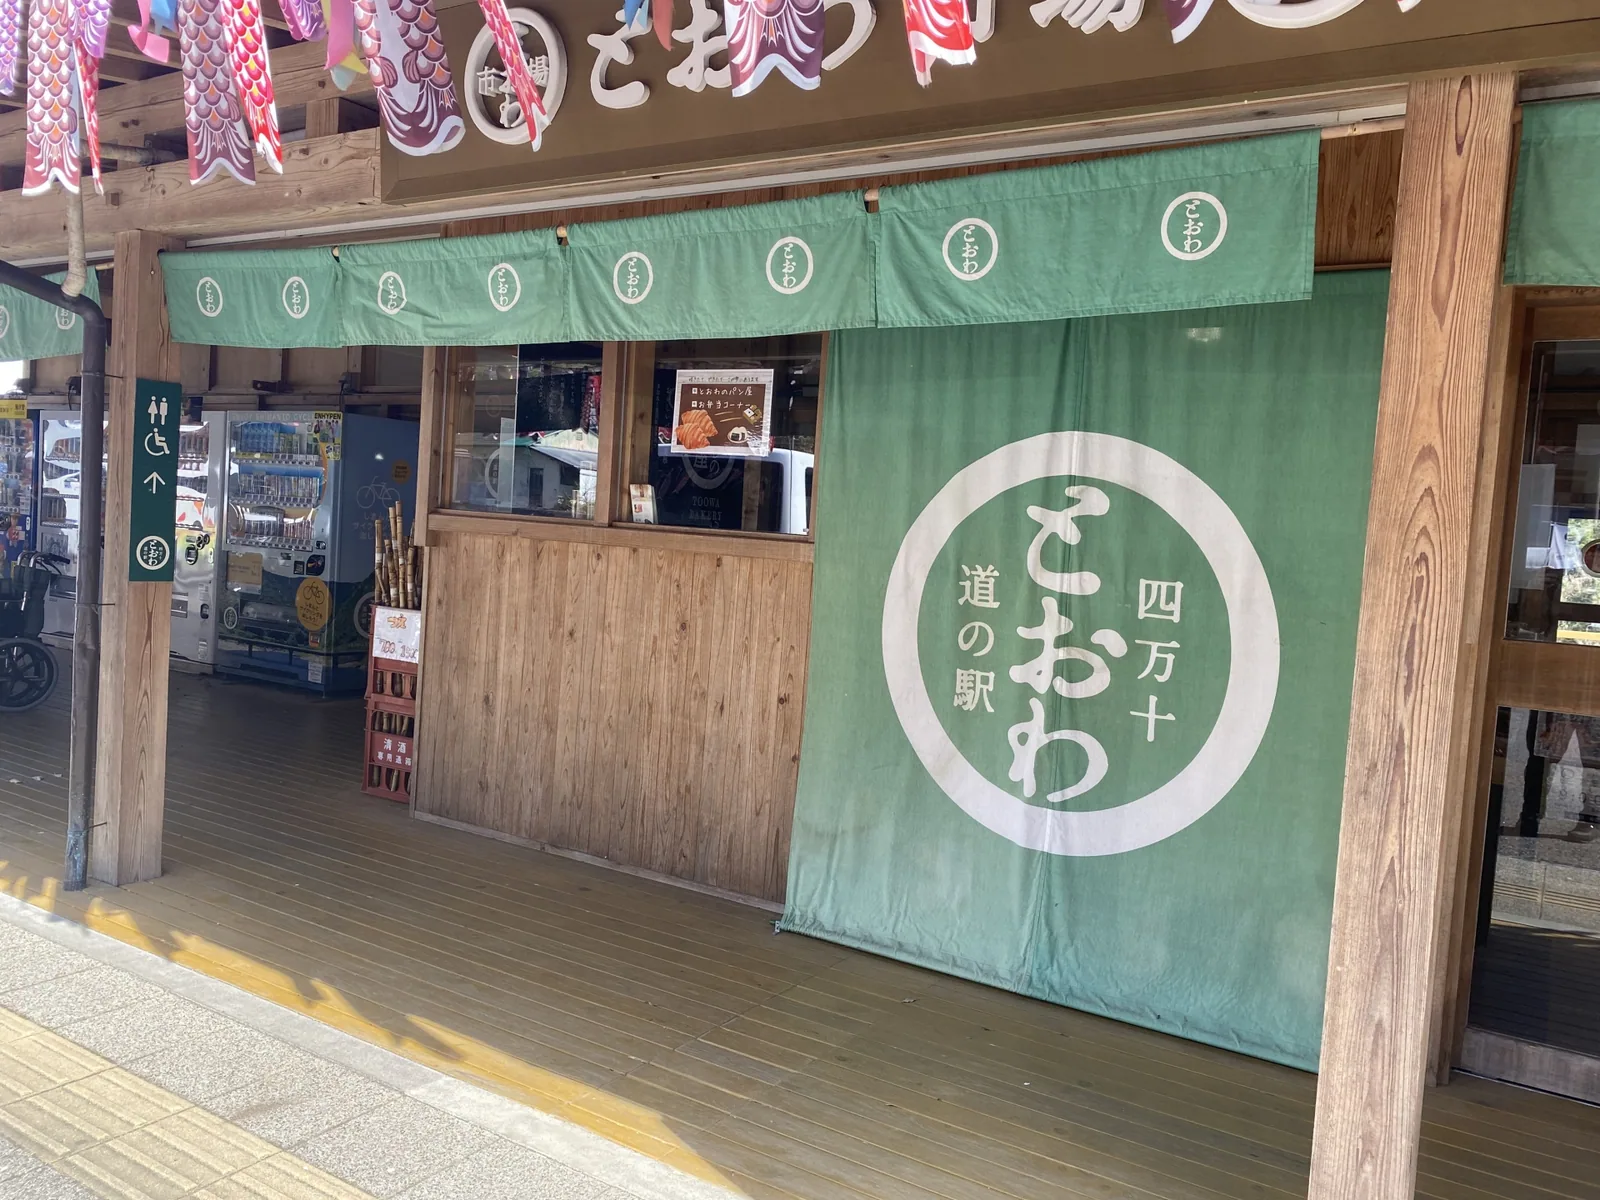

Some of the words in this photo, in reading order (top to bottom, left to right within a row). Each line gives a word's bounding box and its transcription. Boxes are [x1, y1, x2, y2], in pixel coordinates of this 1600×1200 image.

[1183, 199, 1203, 253] とおわ
[781, 243, 796, 288] とおわ
[962, 225, 979, 274] とおわ
[204, 282, 216, 313] とおわ
[292, 279, 301, 315] とおわ
[386, 275, 398, 311] とおわ
[497, 268, 509, 307] とおわ
[626, 258, 640, 298] とおわ
[698, 400, 751, 409] お弁当コーナー
[700, 386, 753, 396] とおわのパン屋
[314, 412, 341, 420] ENHYPEN
[953, 564, 1000, 712] 道の駅
[1008, 485, 1128, 802] とおわ
[1129, 578, 1184, 742] 四万十
[383, 737, 406, 754] 清酒
